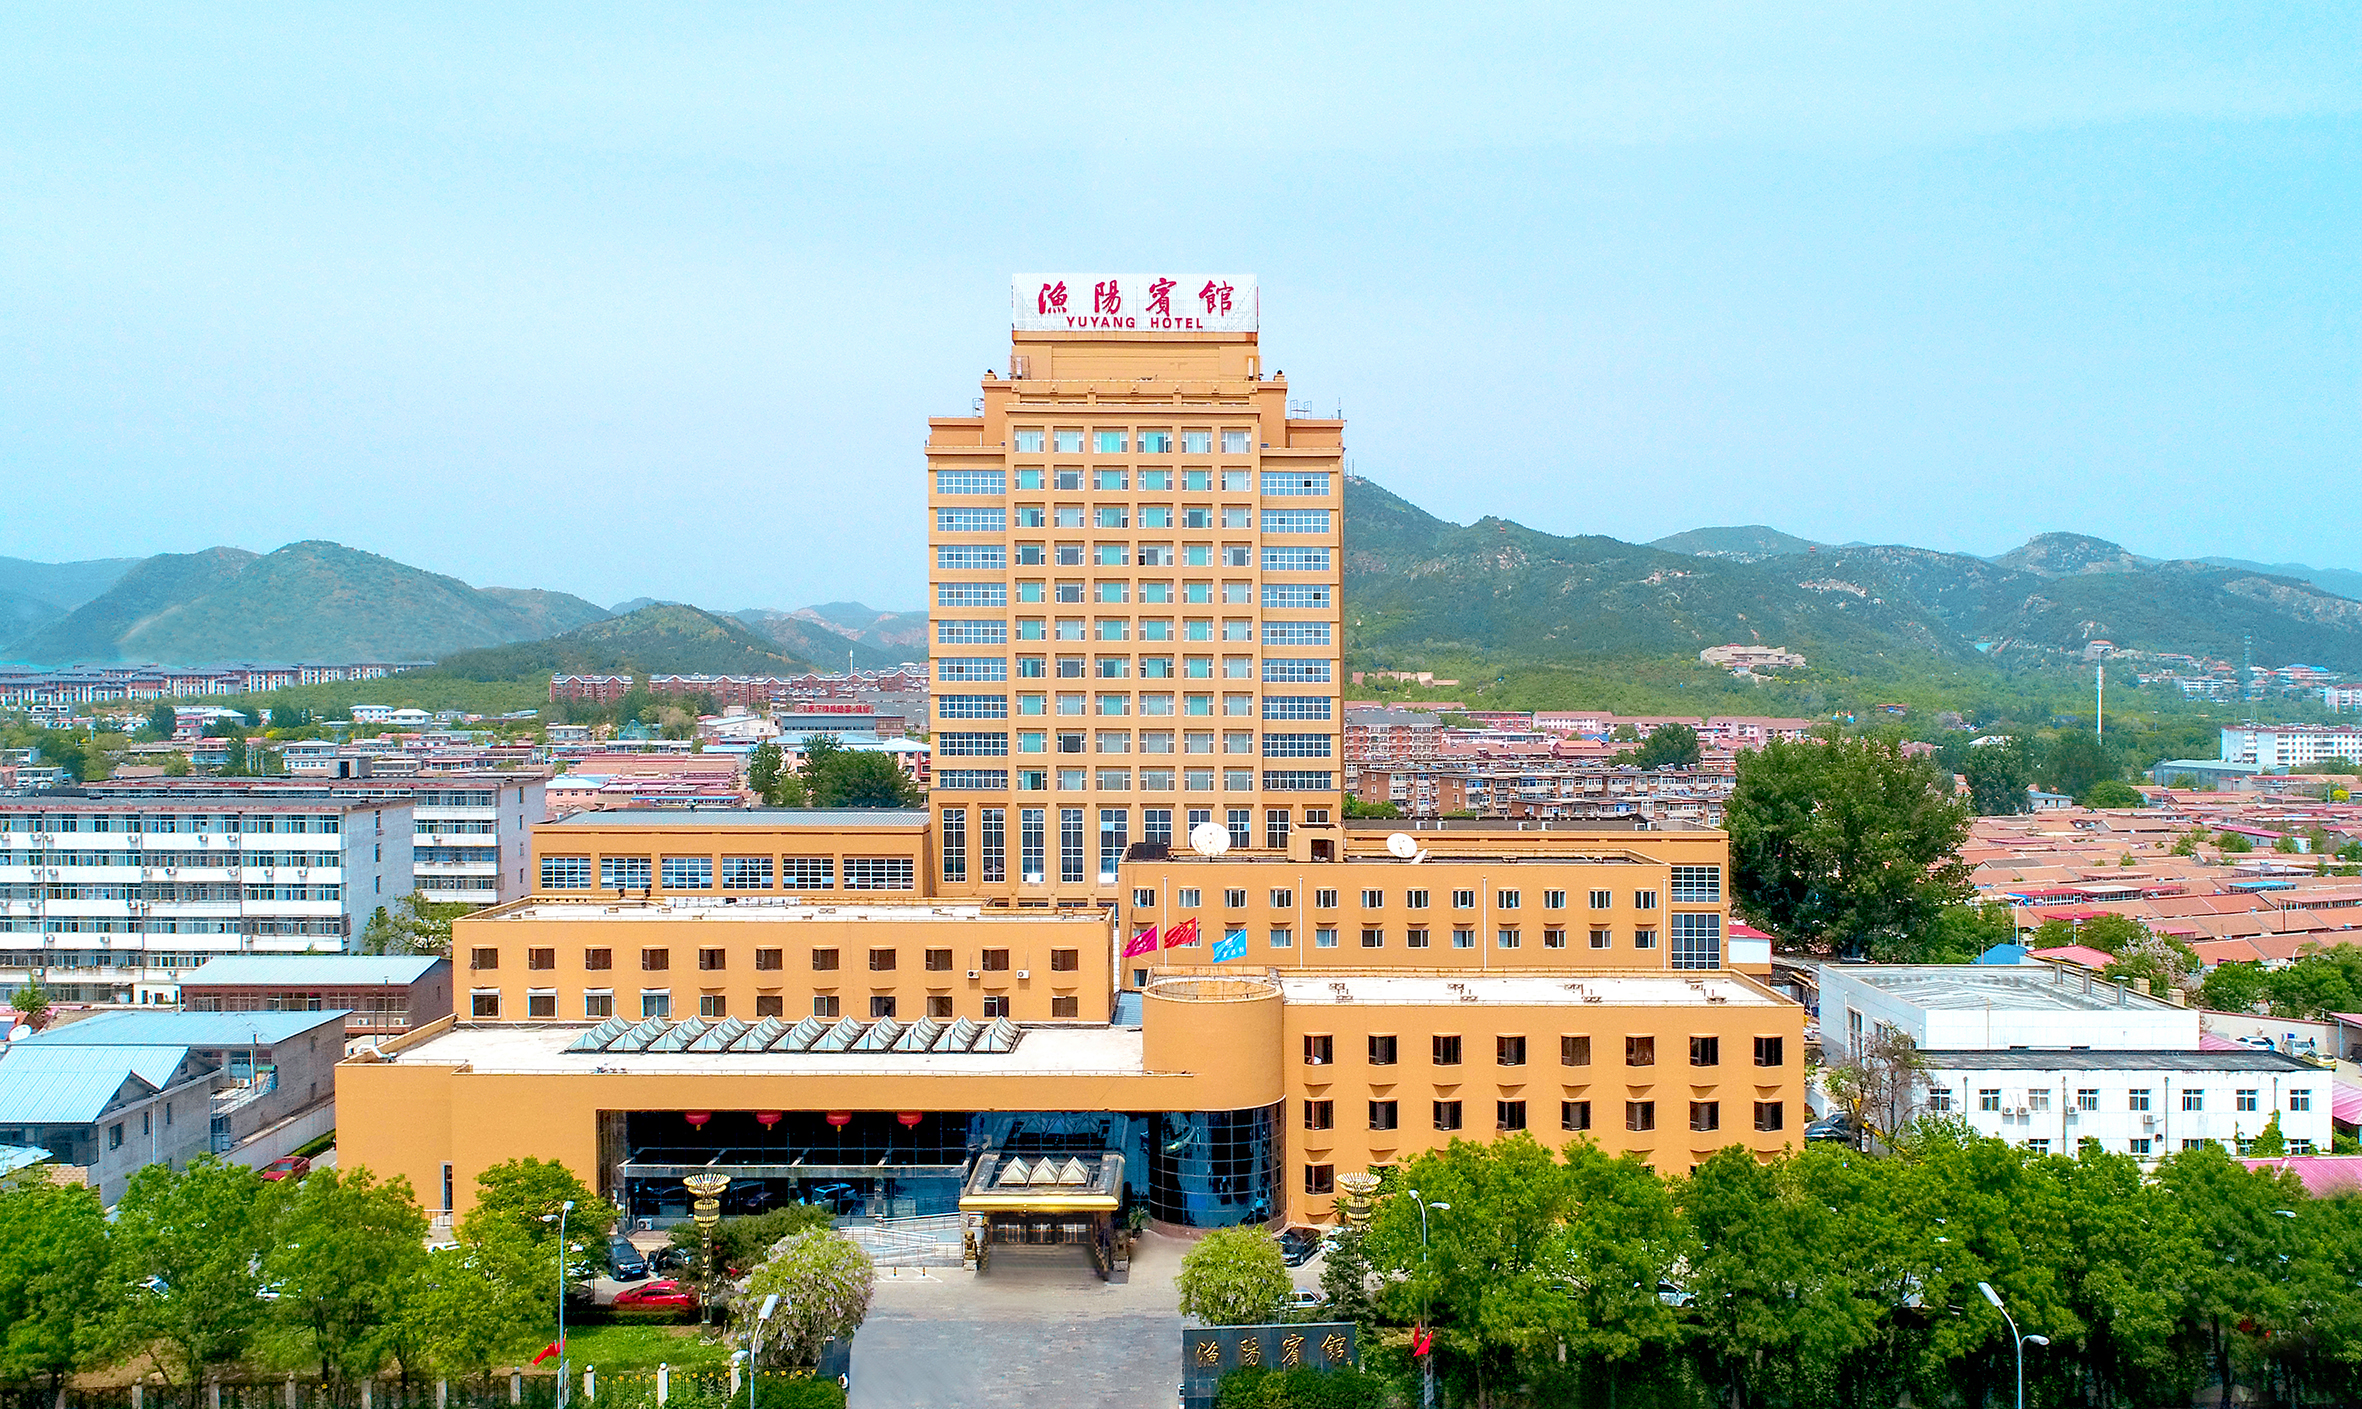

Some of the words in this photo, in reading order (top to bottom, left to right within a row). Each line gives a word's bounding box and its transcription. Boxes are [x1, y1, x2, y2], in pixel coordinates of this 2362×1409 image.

[1038, 277, 1234, 316] 漁陽賓館
[1066, 316, 1136, 329] YUYANG
[1150, 316, 1204, 329] HOTEL
